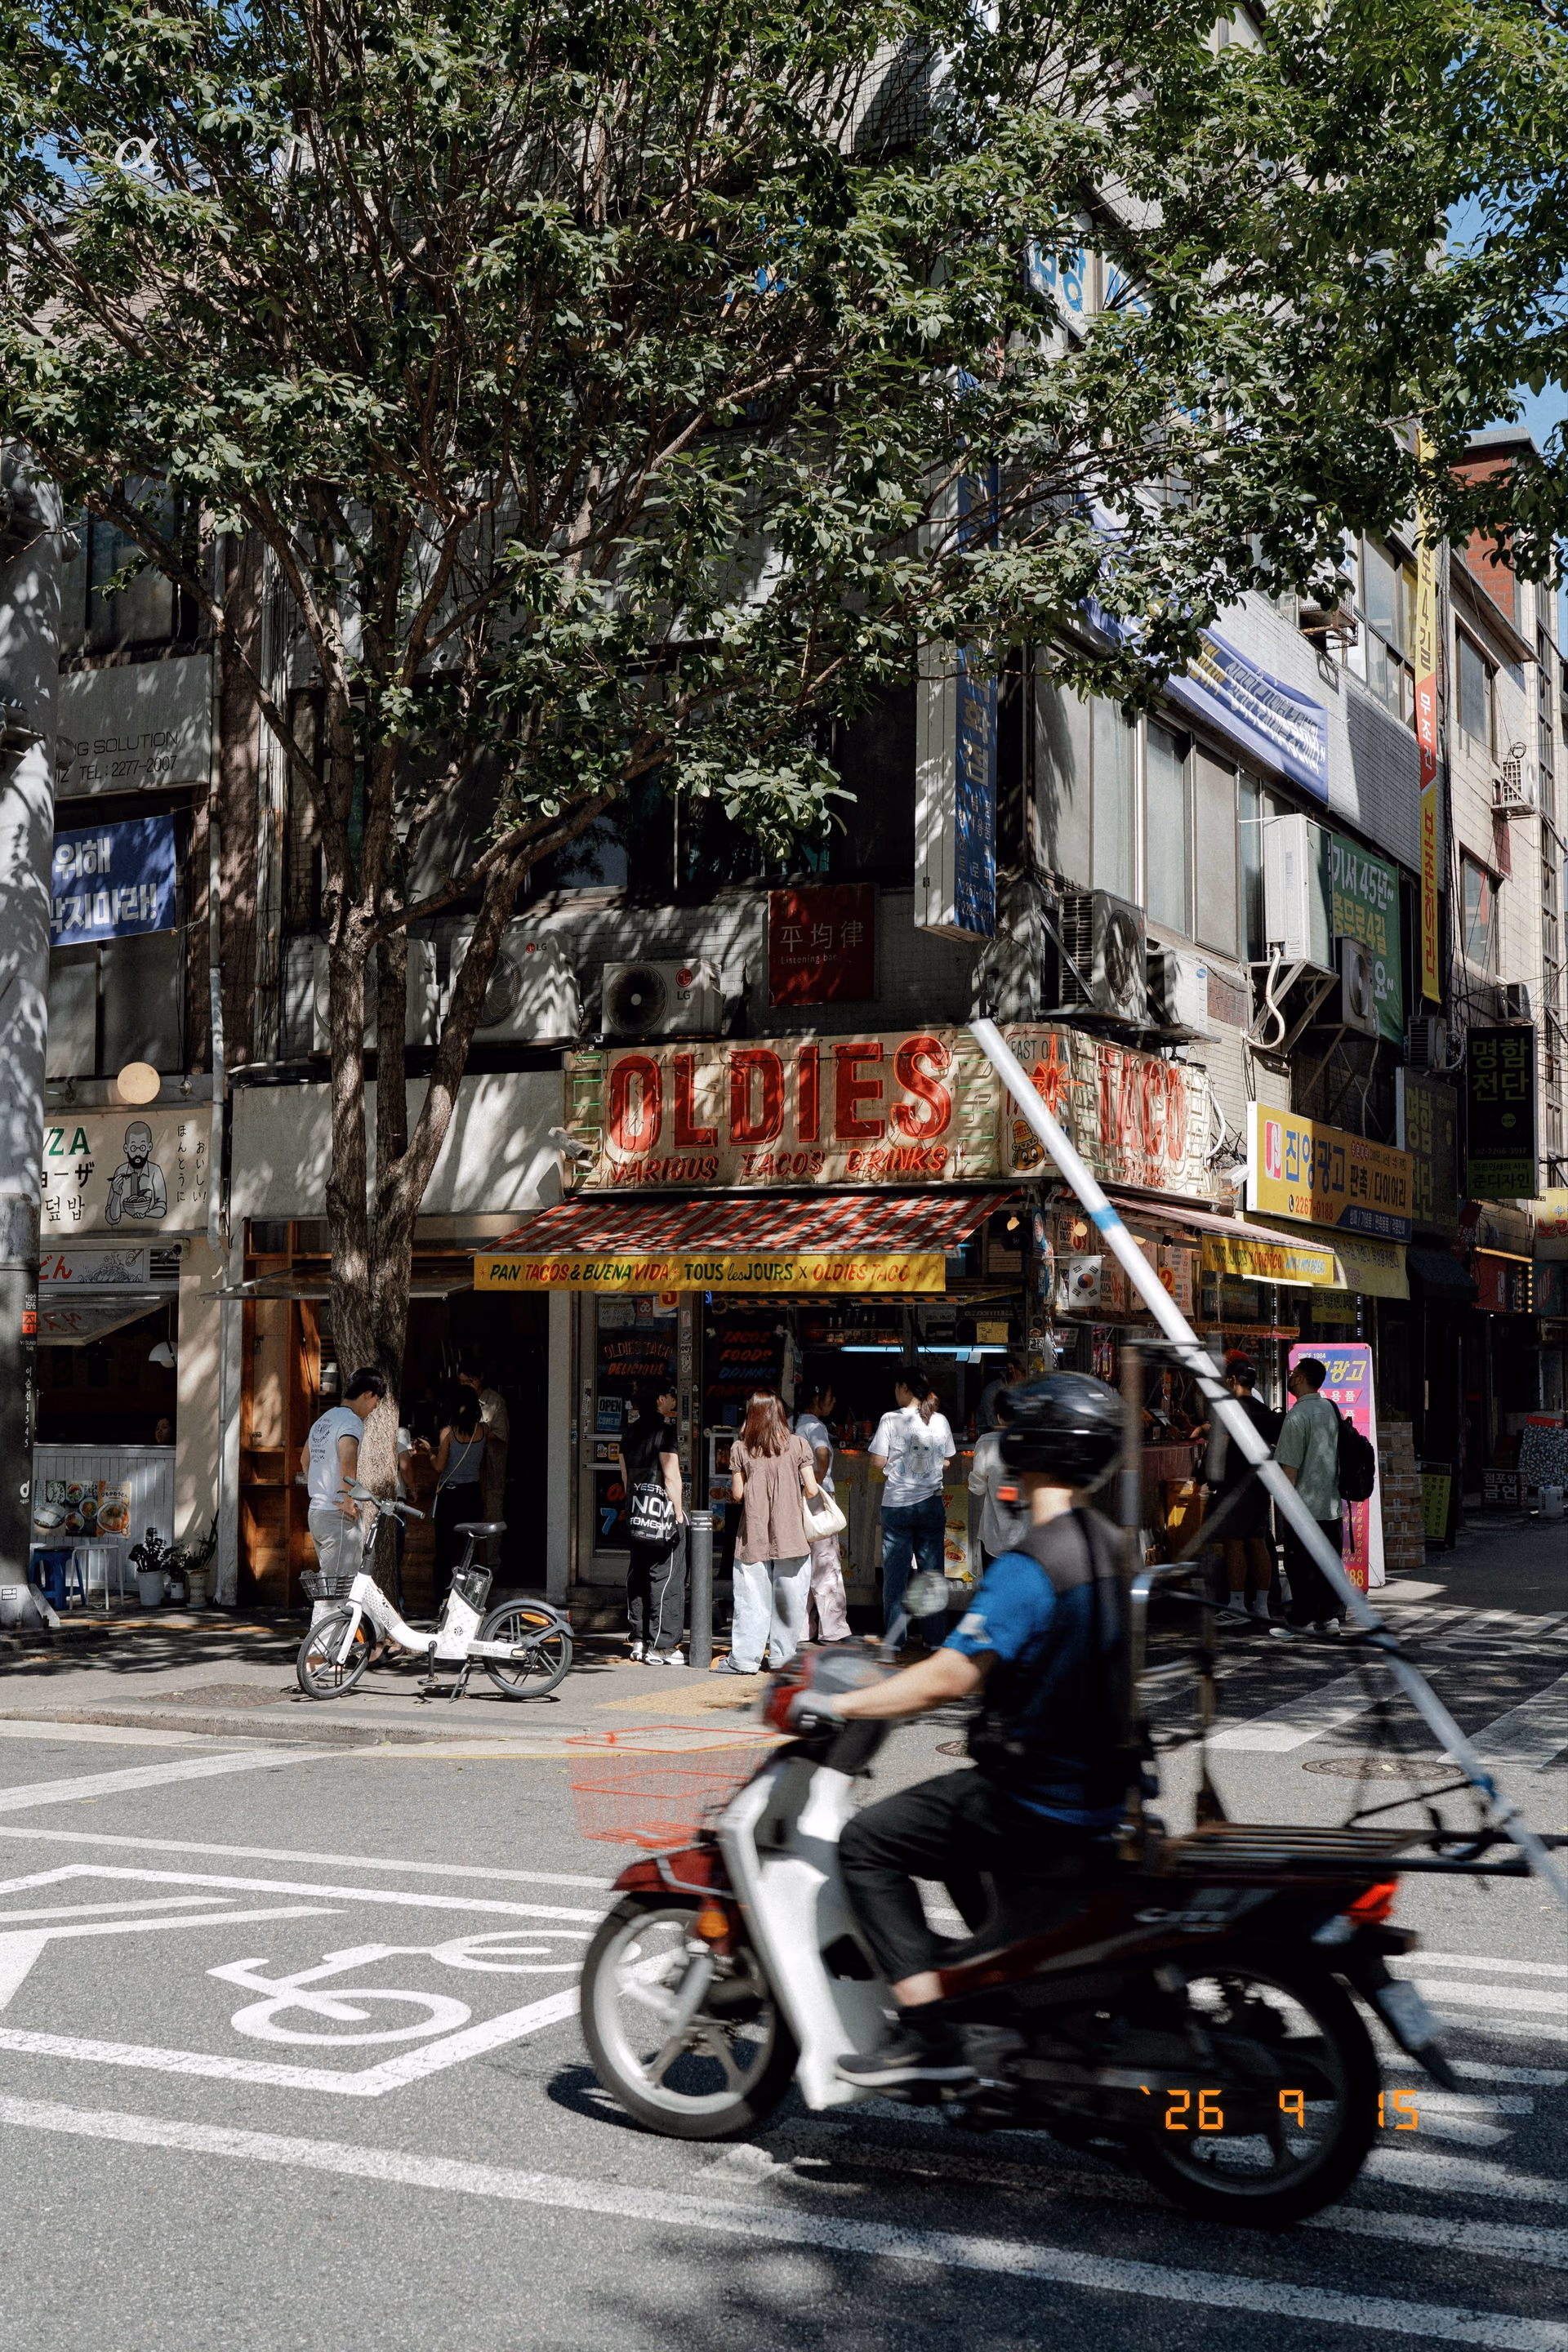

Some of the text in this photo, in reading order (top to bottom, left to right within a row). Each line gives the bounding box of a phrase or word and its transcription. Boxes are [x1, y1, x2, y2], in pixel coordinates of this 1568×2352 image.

[93, 731, 178, 755] SOLUTION
[1420, 692, 1432, 770] 무조건
[79, 764, 101, 781] TEL
[111, 755, 177, 777] 2277-2007
[54, 836, 111, 880] 위해
[1331, 844, 1357, 896] 기서
[780, 920, 864, 953] 平均律
[781, 953, 837, 964] Listening bar
[677, 990, 691, 1000] LG
[1472, 1038, 1529, 1069] 명함
[606, 1034, 952, 1153] OLDIES
[1472, 1071, 1530, 1102] 전단
[176, 1125, 187, 1203] ほんとうに
[612, 1145, 948, 1183] VARIOUS TACOS DRINKS
[1285, 1129, 1346, 1194] 진영광고
[1472, 1173, 1530, 1190] 준디자인
[45, 1194, 85, 1222] 덮밥
[1295, 1195, 1334, 1221] 2267-0188
[582, 1263, 631, 1281] BUENA
[684, 1263, 724, 1281] TOUS
[727, 1263, 744, 1281] les
[744, 1263, 793, 1281] JOURS
[813, 1263, 868, 1281] OLDIES
[871, 1263, 911, 1282] TACO
[722, 1330, 772, 1344] TACOS
[719, 1348, 773, 1362] FOODS
[608, 1362, 666, 1376] DELICIOUS
[599, 1399, 621, 1413] OPEN
[1483, 1472, 1518, 1484] 점포앞
[1483, 1484, 1518, 1501] 금연
[379, 1612, 395, 1632] SWING
